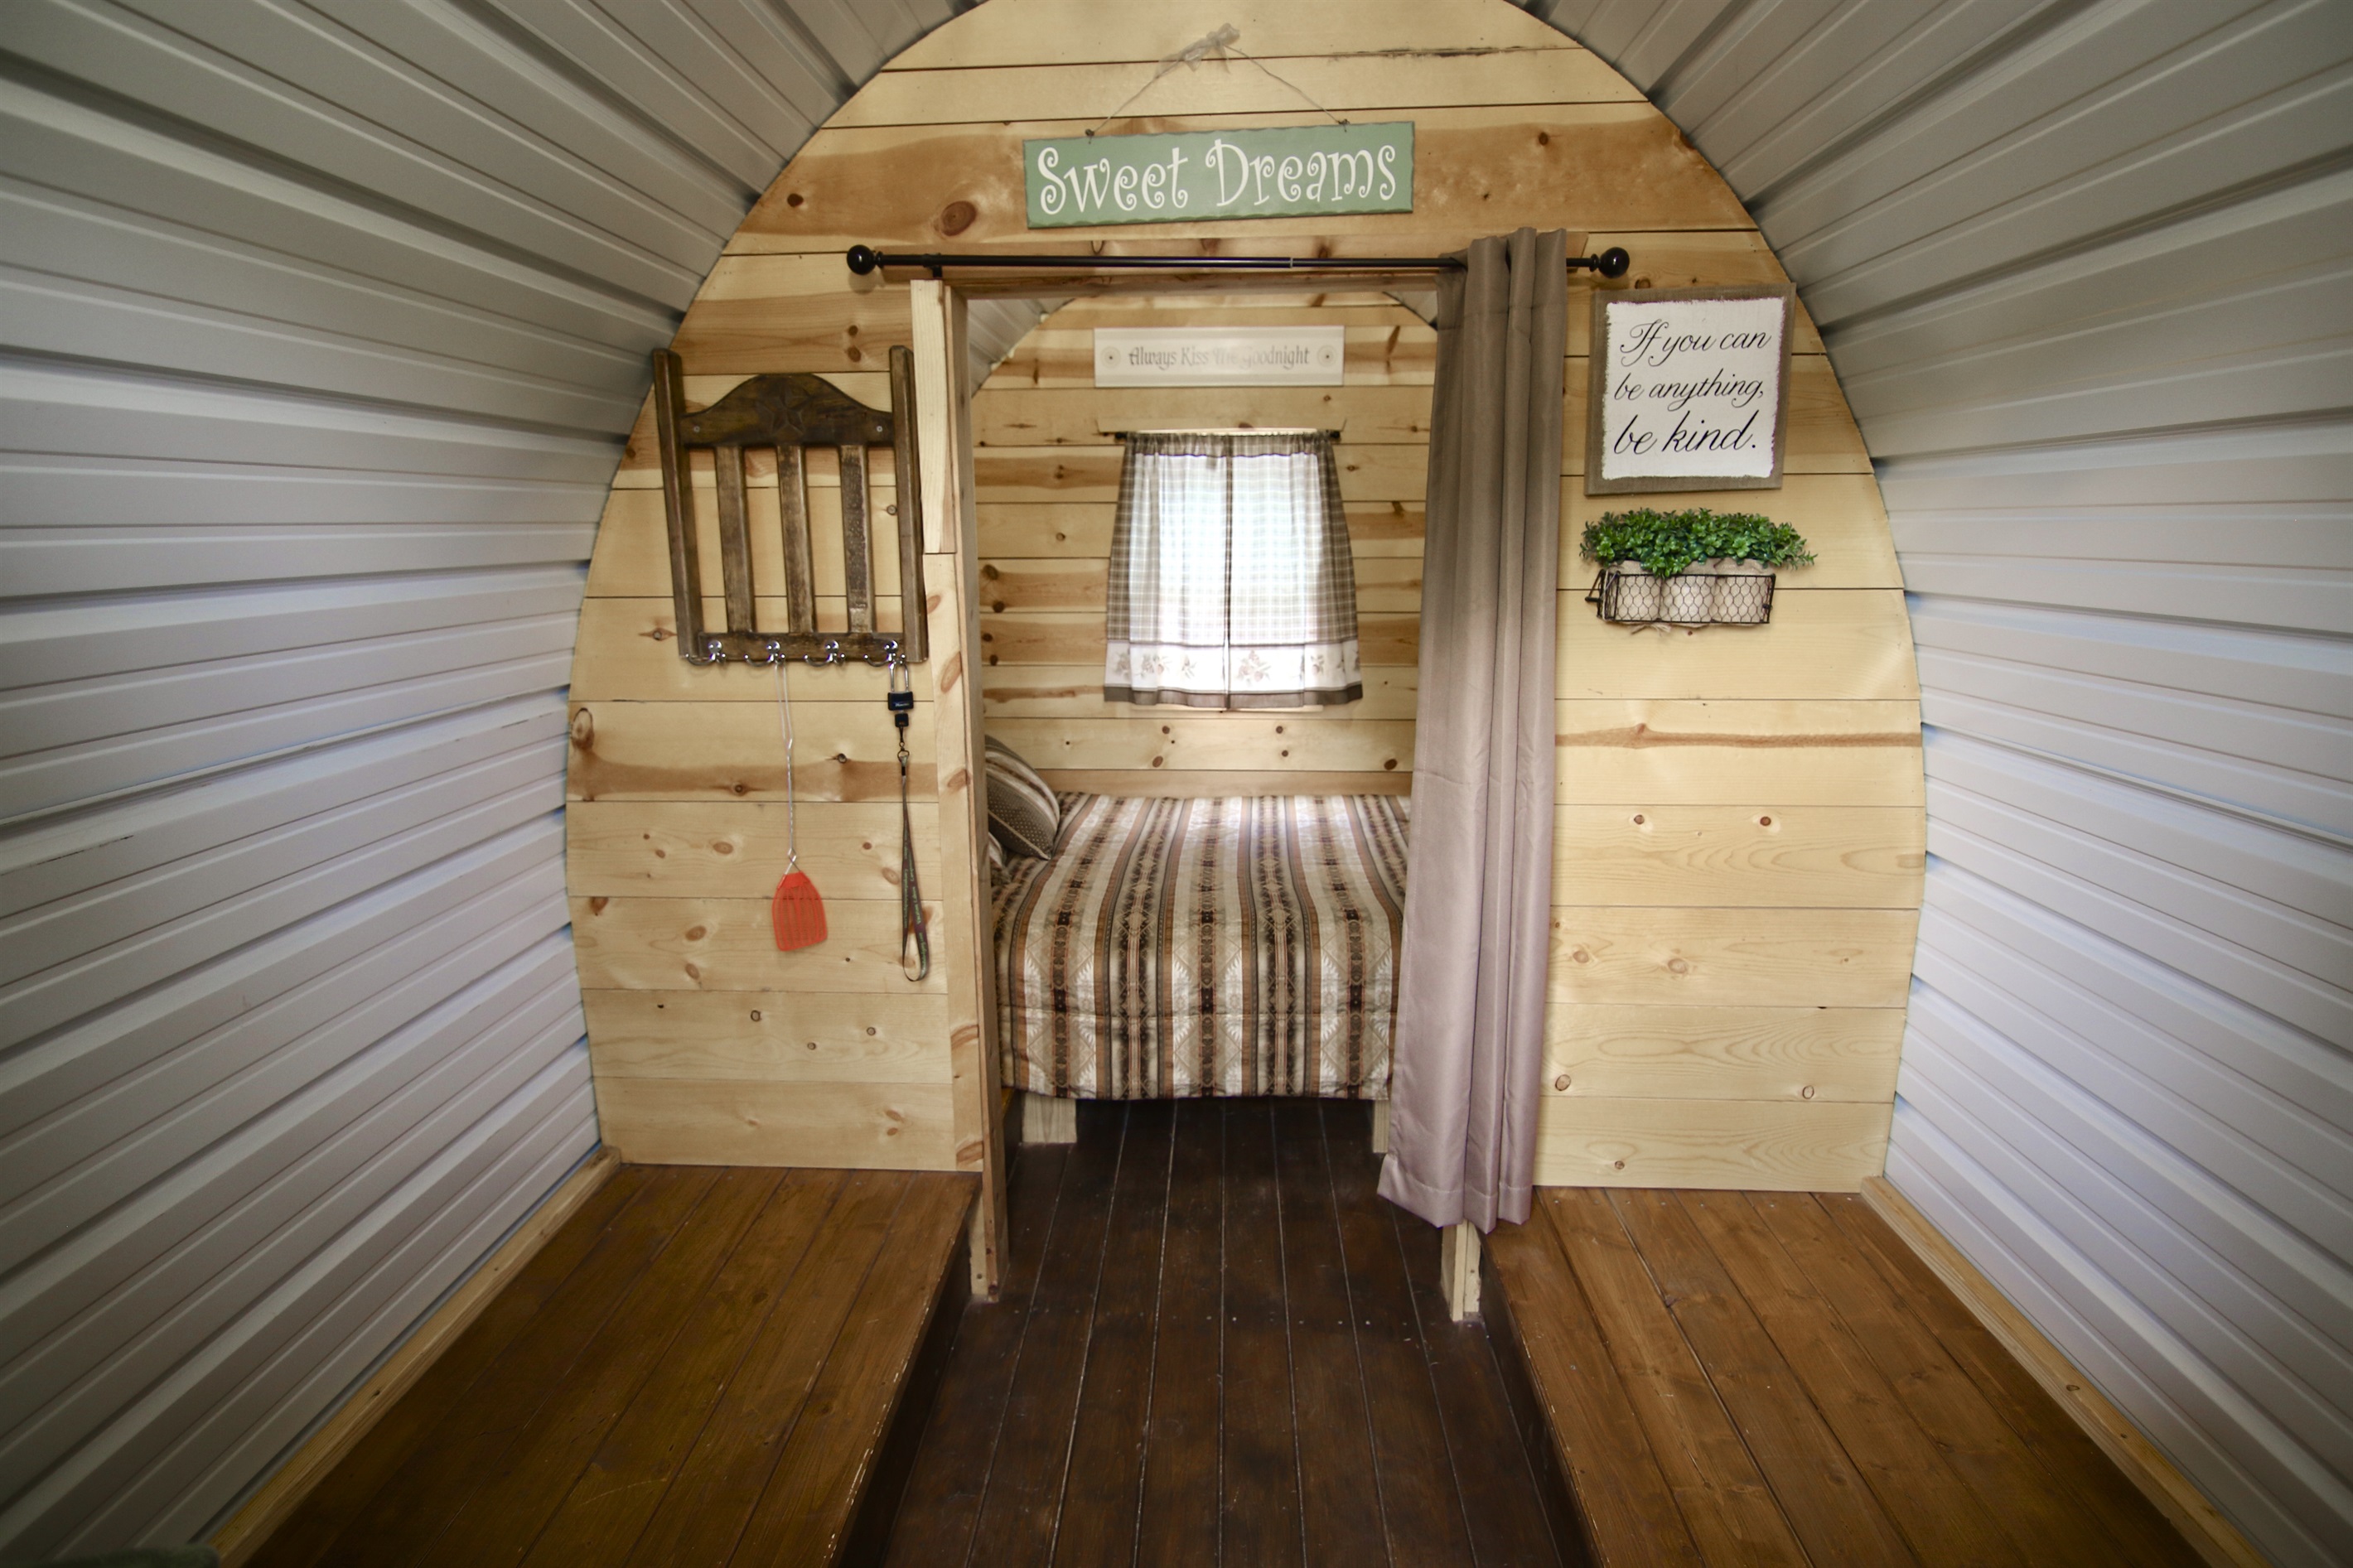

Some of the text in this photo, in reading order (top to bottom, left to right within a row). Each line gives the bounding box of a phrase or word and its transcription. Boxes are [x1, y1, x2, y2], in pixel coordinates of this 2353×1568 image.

[1037, 138, 1397, 215] Sweet Dreams
[1128, 346, 1177, 370] Always
[1181, 345, 1209, 367] Kiss
[1239, 345, 1310, 370] Goodnight
[1620, 319, 1772, 367] If you can
[1614, 368, 1764, 412] be anything,
[1614, 409, 1759, 455] be kind.
